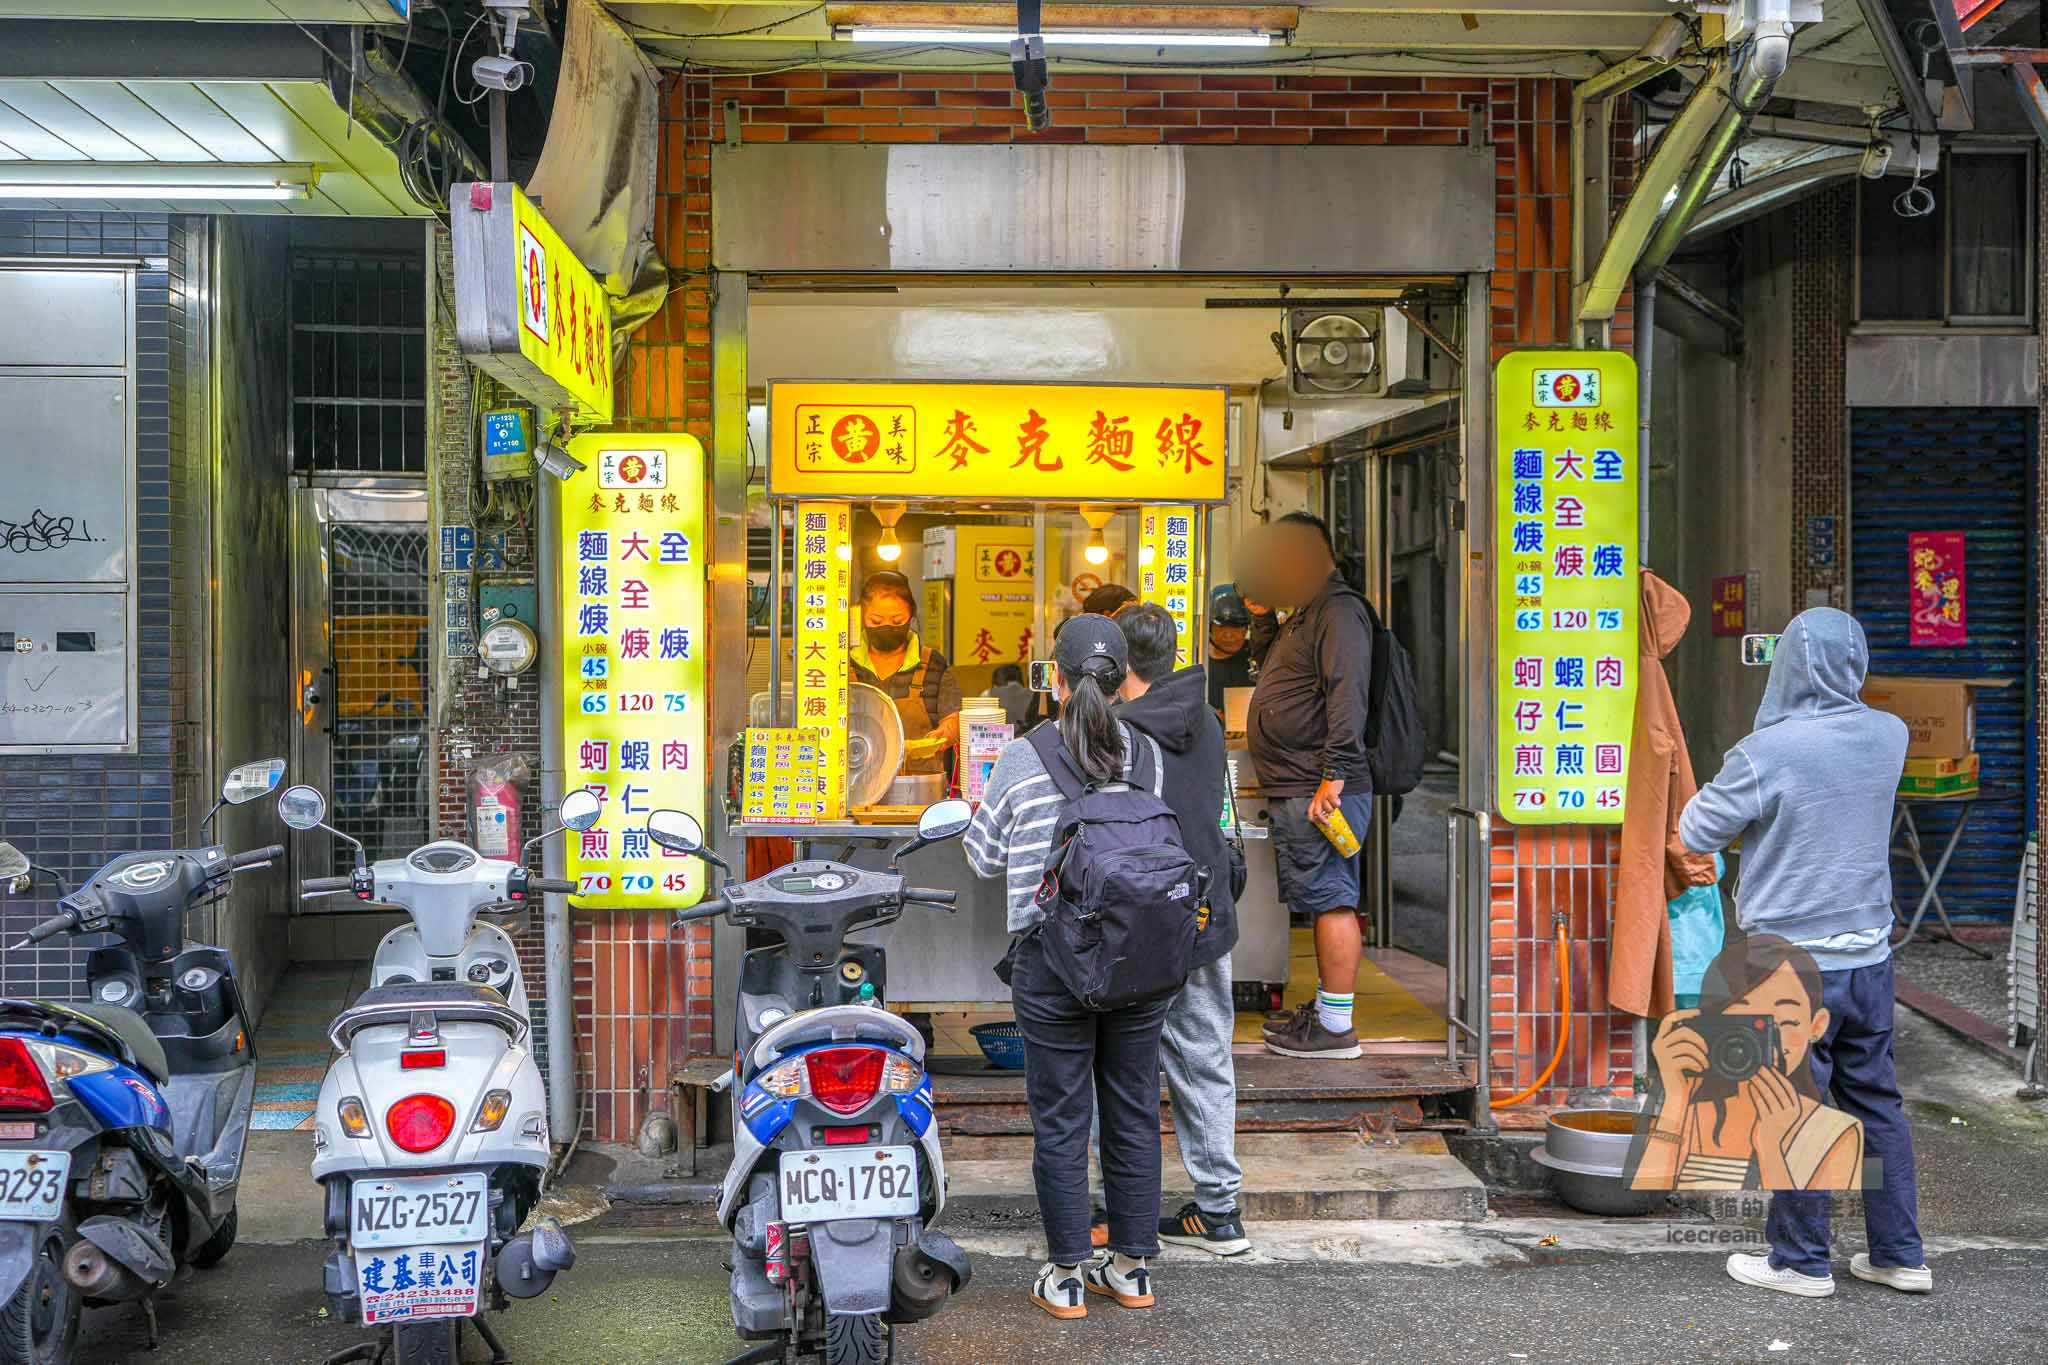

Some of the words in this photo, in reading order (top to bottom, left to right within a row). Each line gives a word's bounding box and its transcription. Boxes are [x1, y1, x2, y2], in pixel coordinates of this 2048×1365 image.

[1537, 374, 1549, 402] 正宗
[1557, 376, 1577, 401] 黃
[1584, 373, 1596, 403] 美味
[1521, 411, 1615, 432] 麥克麵線
[805, 414, 824, 463] 正宗
[836, 419, 876, 461] 黃
[886, 415, 907, 465] 美味
[933, 409, 1214, 474] 麥克麵線
[604, 456, 615, 484] 正宗
[623, 458, 643, 482] 黃
[650, 456, 662, 484] 美味
[587, 493, 680, 513] 麥克麵線
[1513, 449, 1543, 553] 麵線焿
[1555, 449, 1583, 576] 大全焿
[1593, 450, 1623, 576] 全焿
[804, 513, 826, 580] 麵線焿
[1166, 517, 1188, 583] 麵線焿
[1517, 561, 1542, 571] 小碗
[579, 531, 608, 635] 麵線焿
[1517, 576, 1541, 594] 45
[621, 532, 649, 659] 大全焿
[660, 533, 689, 659] 全焿
[806, 595, 824, 606] 45
[1168, 598, 1184, 609] 45
[806, 618, 824, 628] 65
[1517, 611, 1541, 629] 65
[1553, 611, 1587, 628] 120
[1597, 611, 1619, 628] 75
[583, 644, 607, 654] 小碗
[582, 658, 606, 676] 45
[583, 679, 607, 690] 大碗
[804, 641, 826, 716] 大全焿
[582, 695, 606, 713] 65
[619, 694, 654, 711] 120
[664, 694, 685, 712] 75
[1514, 657, 1543, 775] 蚵仔煎
[1555, 657, 1584, 775] 蝦仁煎
[1596, 657, 1621, 773] 肉圓
[621, 740, 650, 858] 蝦仁煎
[1513, 792, 1545, 806] 70
[1558, 791, 1584, 807] 70
[1596, 790, 1620, 807] 45
[580, 876, 612, 890] 70
[621, 876, 653, 890] 70
[663, 874, 685, 891] 45
[376, 1306, 410, 1318] SYM
